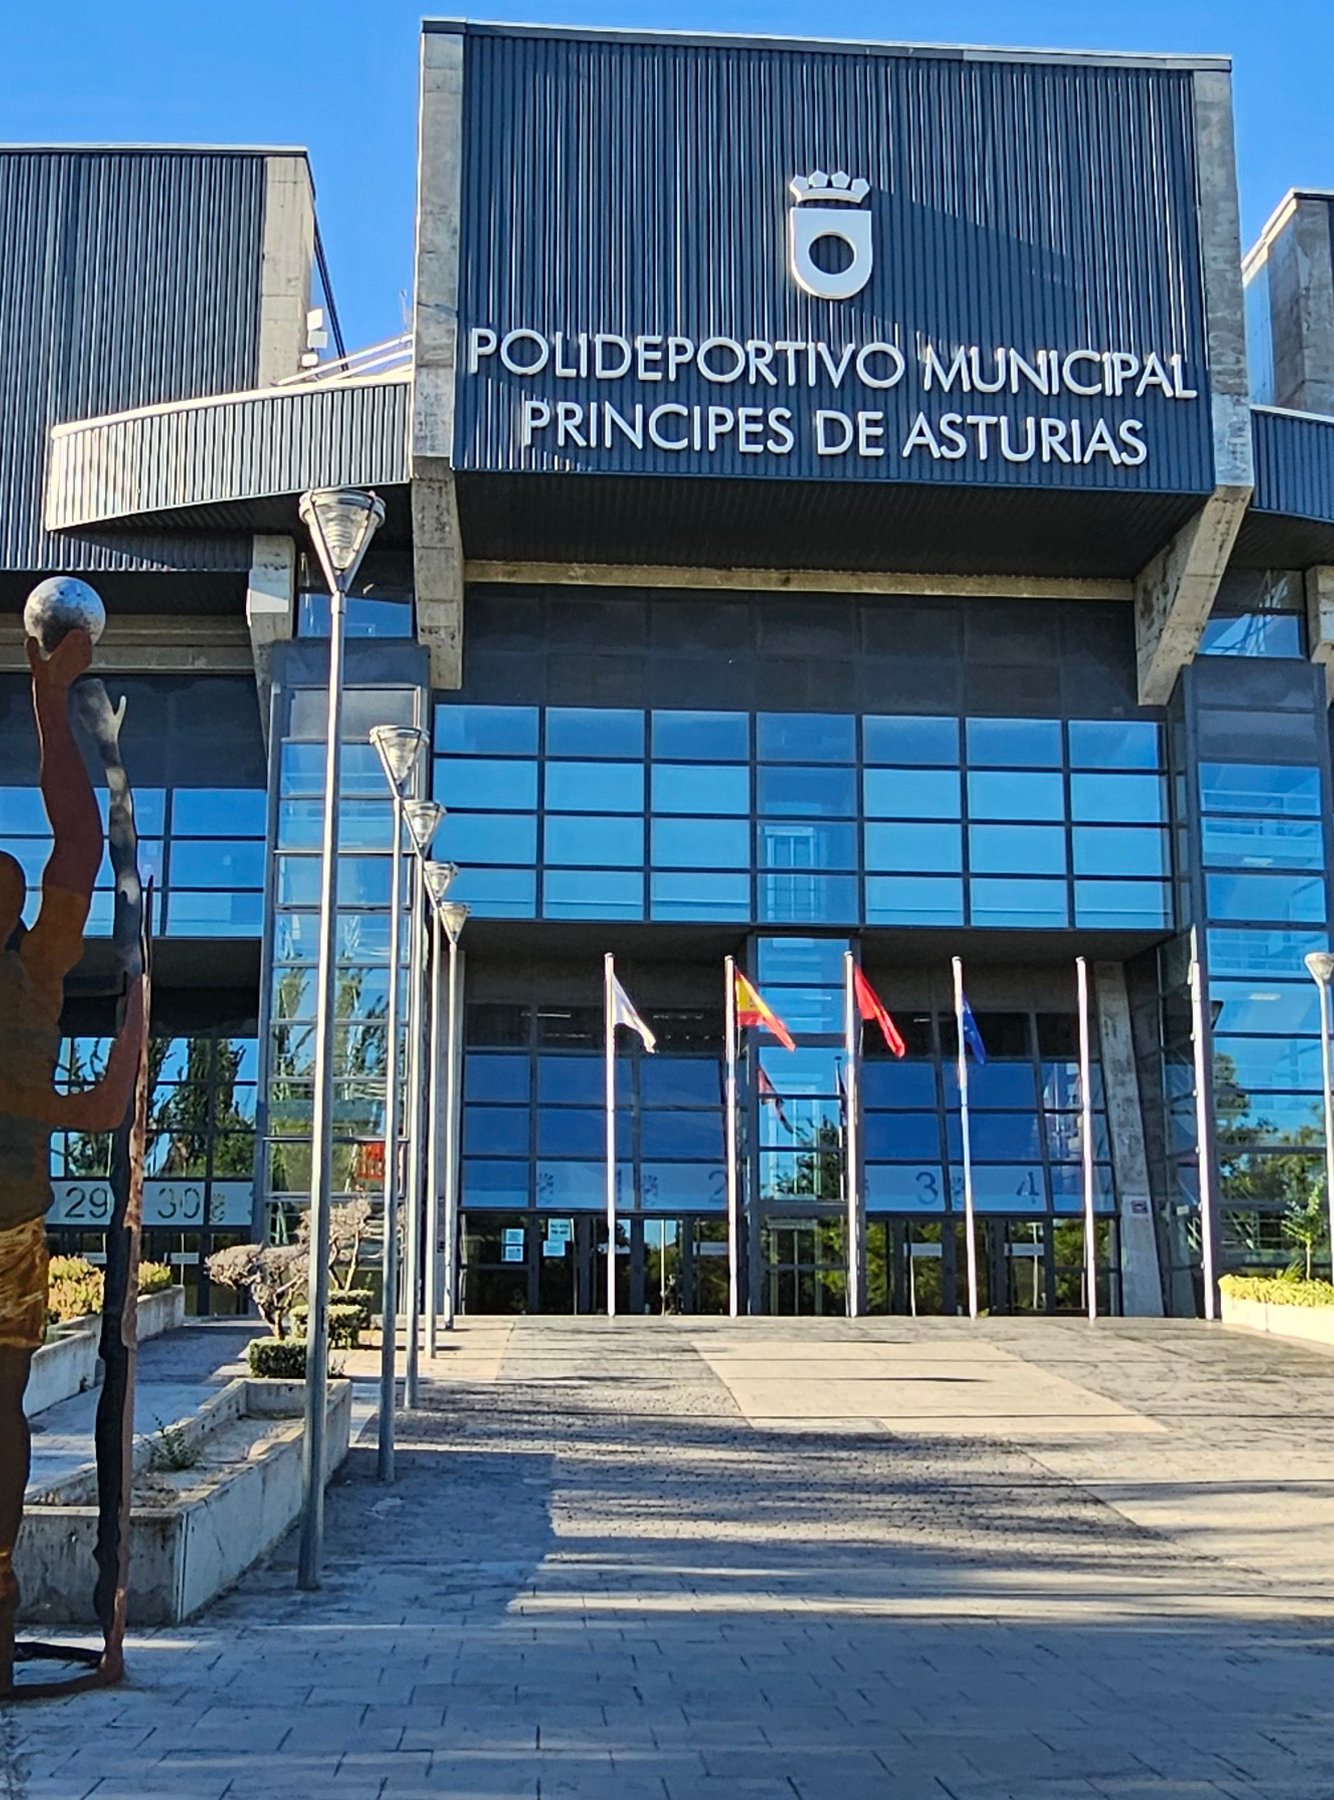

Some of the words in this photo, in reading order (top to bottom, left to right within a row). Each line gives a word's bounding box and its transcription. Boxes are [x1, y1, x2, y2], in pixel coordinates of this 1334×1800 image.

[471, 328, 905, 389] POLIDEPORTIVO
[923, 344, 1198, 399] MUNICIPAL
[524, 400, 795, 455] PRINCIPES
[816, 409, 885, 457] DE
[902, 411, 1148, 466] ASTURIAS
[64, 1186, 109, 1219] 29
[157, 1187, 201, 1219] 30
[915, 1170, 938, 1206] 3
